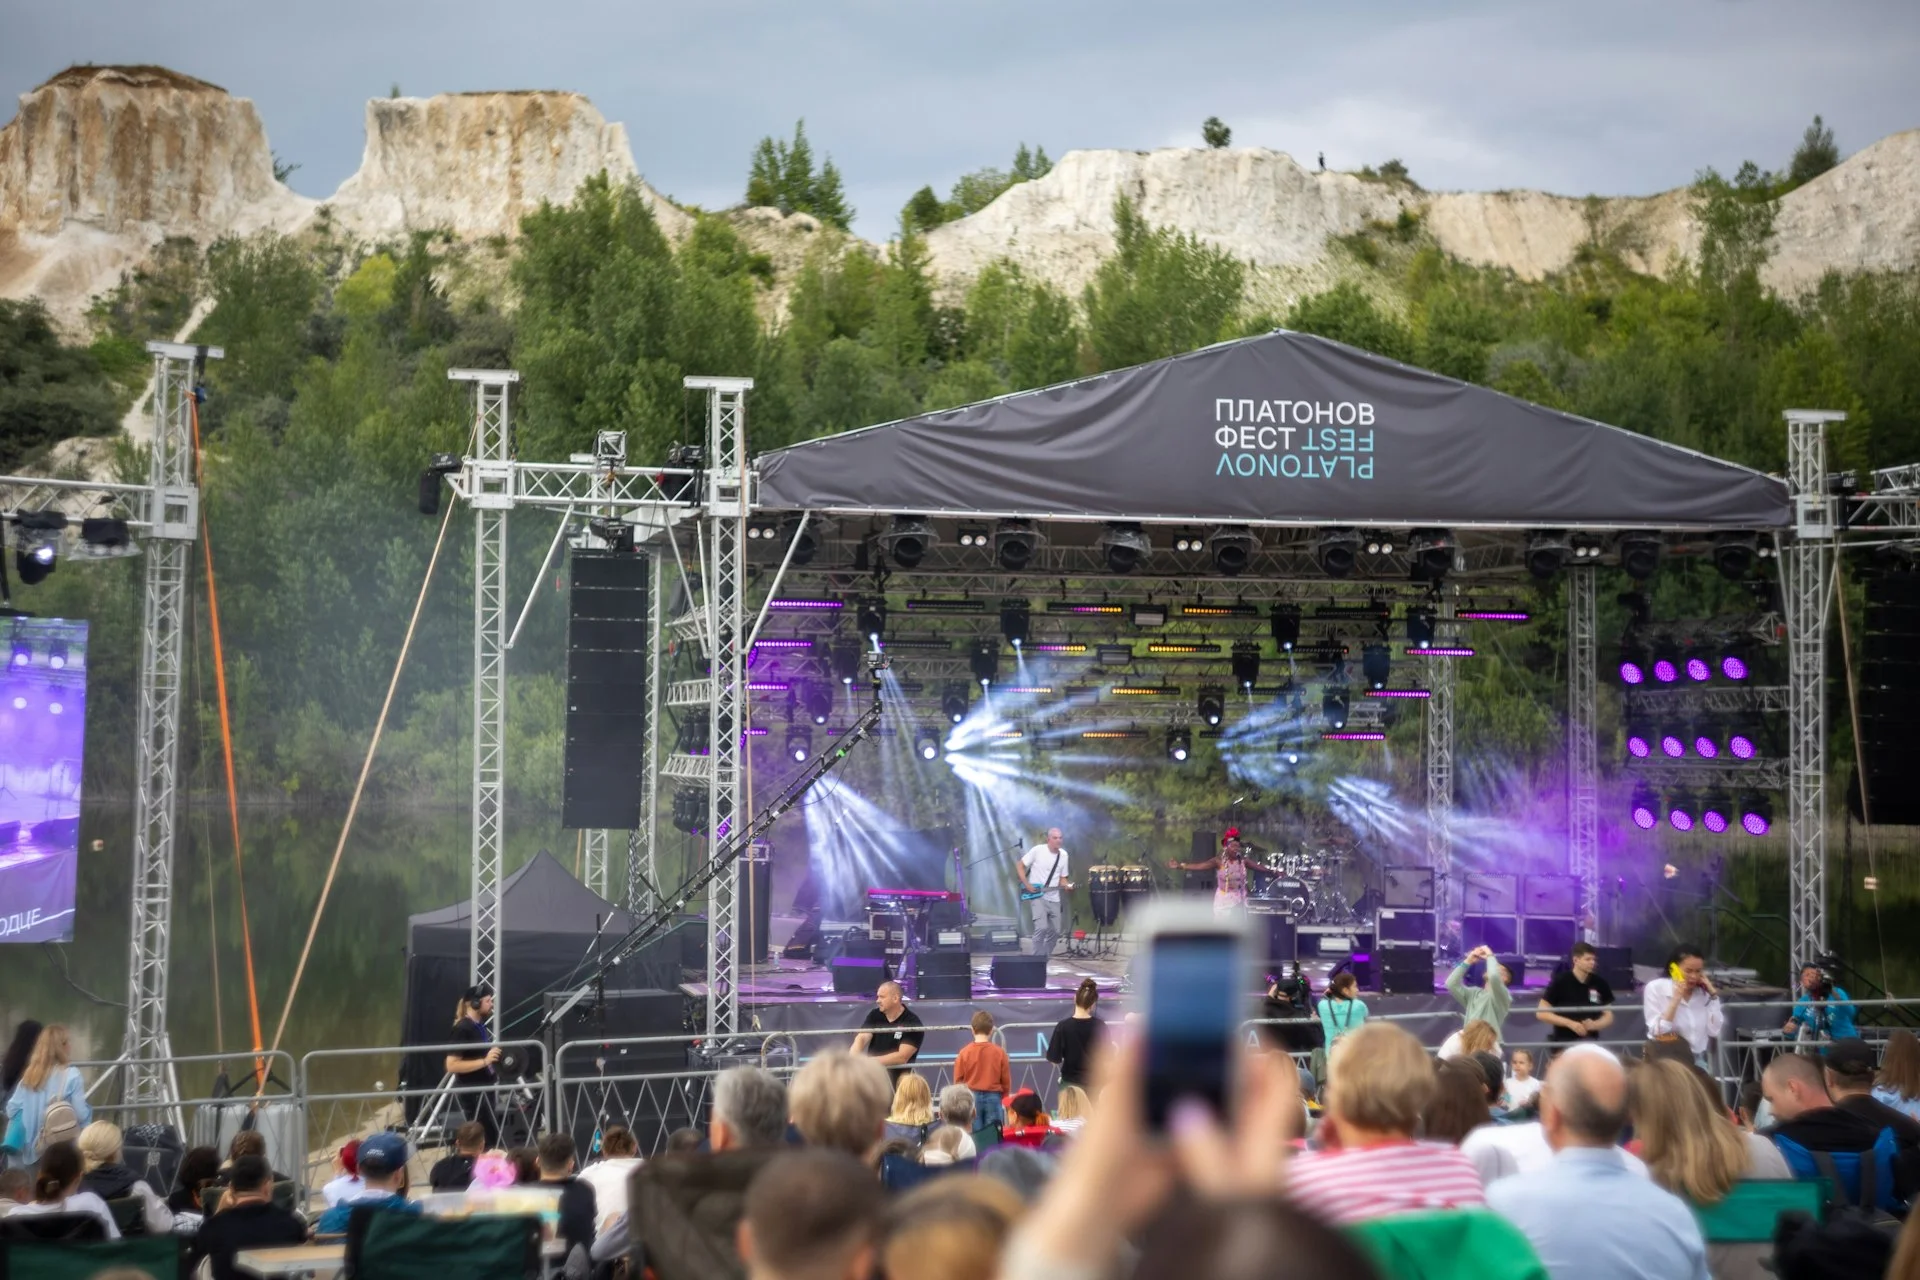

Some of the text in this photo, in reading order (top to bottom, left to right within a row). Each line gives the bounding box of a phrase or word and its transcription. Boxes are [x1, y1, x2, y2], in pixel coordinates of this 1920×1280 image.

[1215, 398, 1375, 425] ПЛАТОНОВ
[1215, 425, 1296, 450] ФЕСТ
[1301, 428, 1374, 452] FEST
[1216, 453, 1374, 479] PLATONOV
